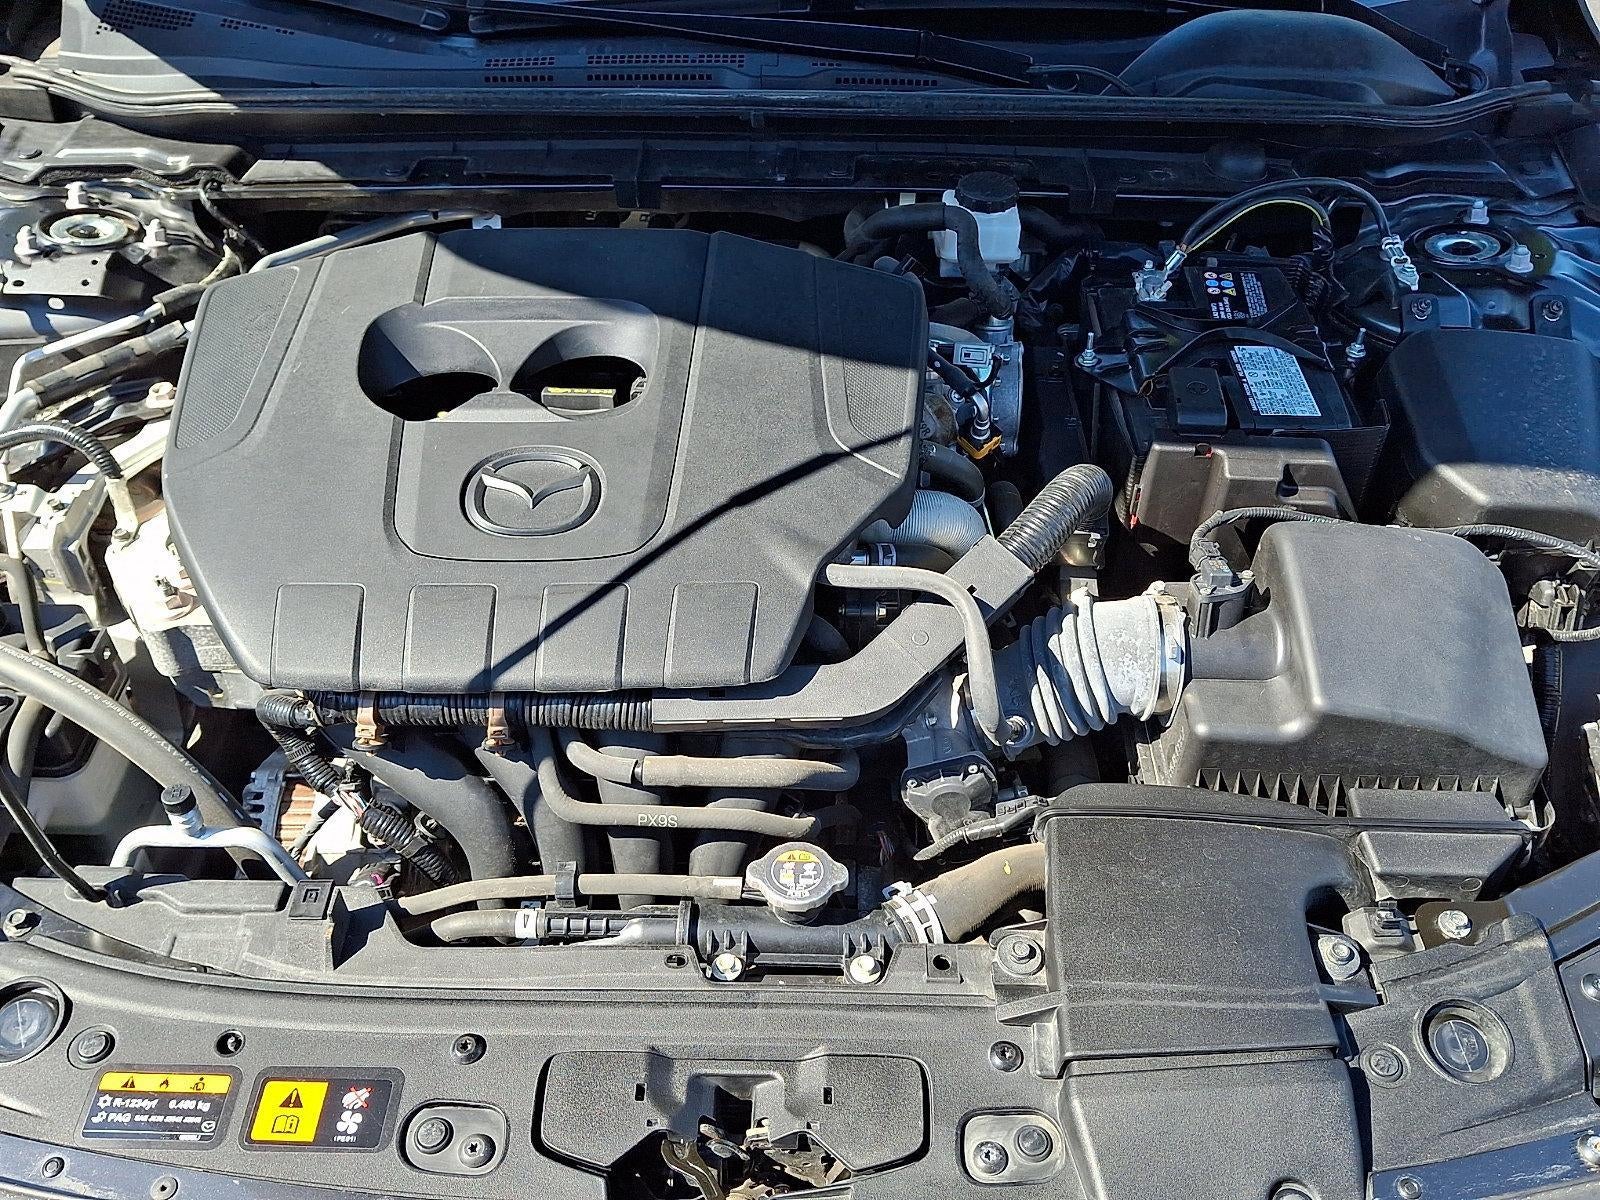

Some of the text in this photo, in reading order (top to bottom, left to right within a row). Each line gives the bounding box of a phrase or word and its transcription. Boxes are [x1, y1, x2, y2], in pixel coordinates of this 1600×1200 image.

[101, 699, 141, 728] FlexBarrier
[156, 740, 199, 774] GALAXY
[637, 813, 678, 828] PX9S
[196, 1100, 211, 1112] kg
[107, 1112, 132, 1122] PAG
